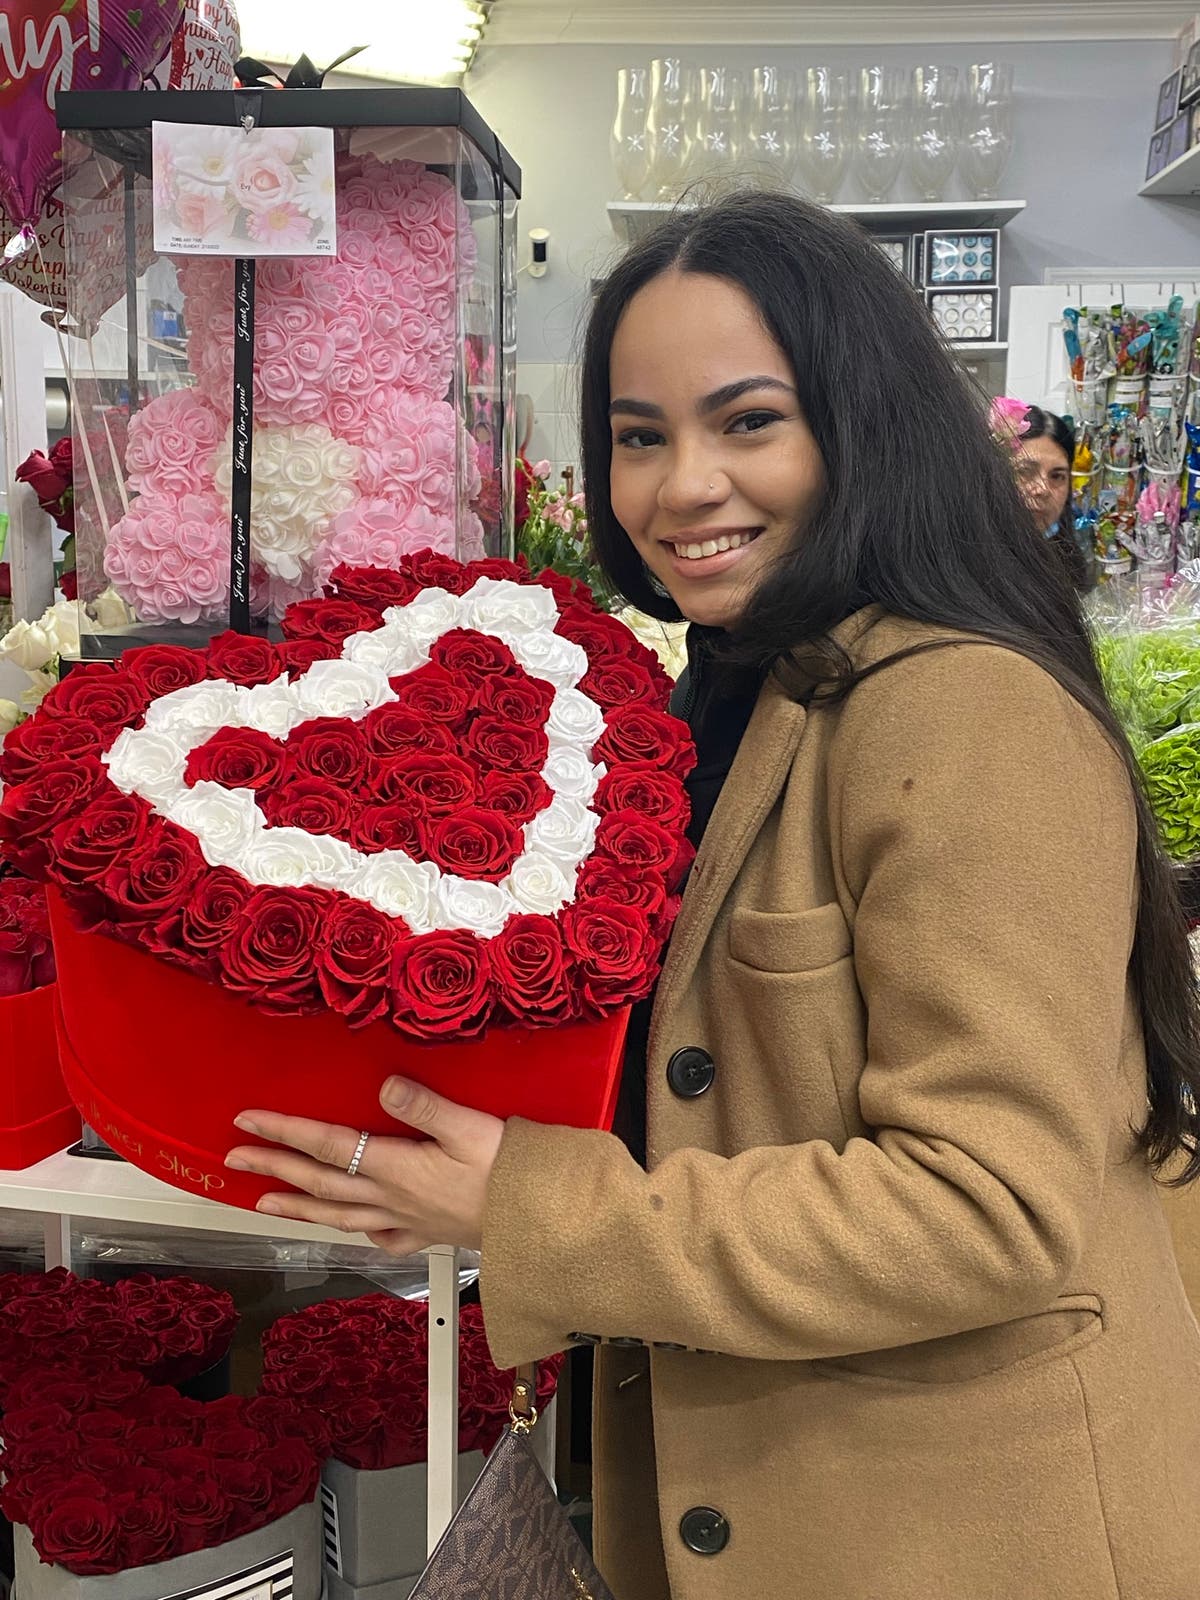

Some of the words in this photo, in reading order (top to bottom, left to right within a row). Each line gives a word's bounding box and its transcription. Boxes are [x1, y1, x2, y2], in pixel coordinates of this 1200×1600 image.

[237, 283, 250, 310] for
[237, 307, 250, 342] Just
[240, 386, 249, 416] you
[237, 417, 249, 444] for
[235, 440, 247, 474] Just
[237, 518, 246, 545] you
[234, 546, 245, 573] for
[233, 569, 244, 602] Just
[155, 1149, 225, 1191] Shop
